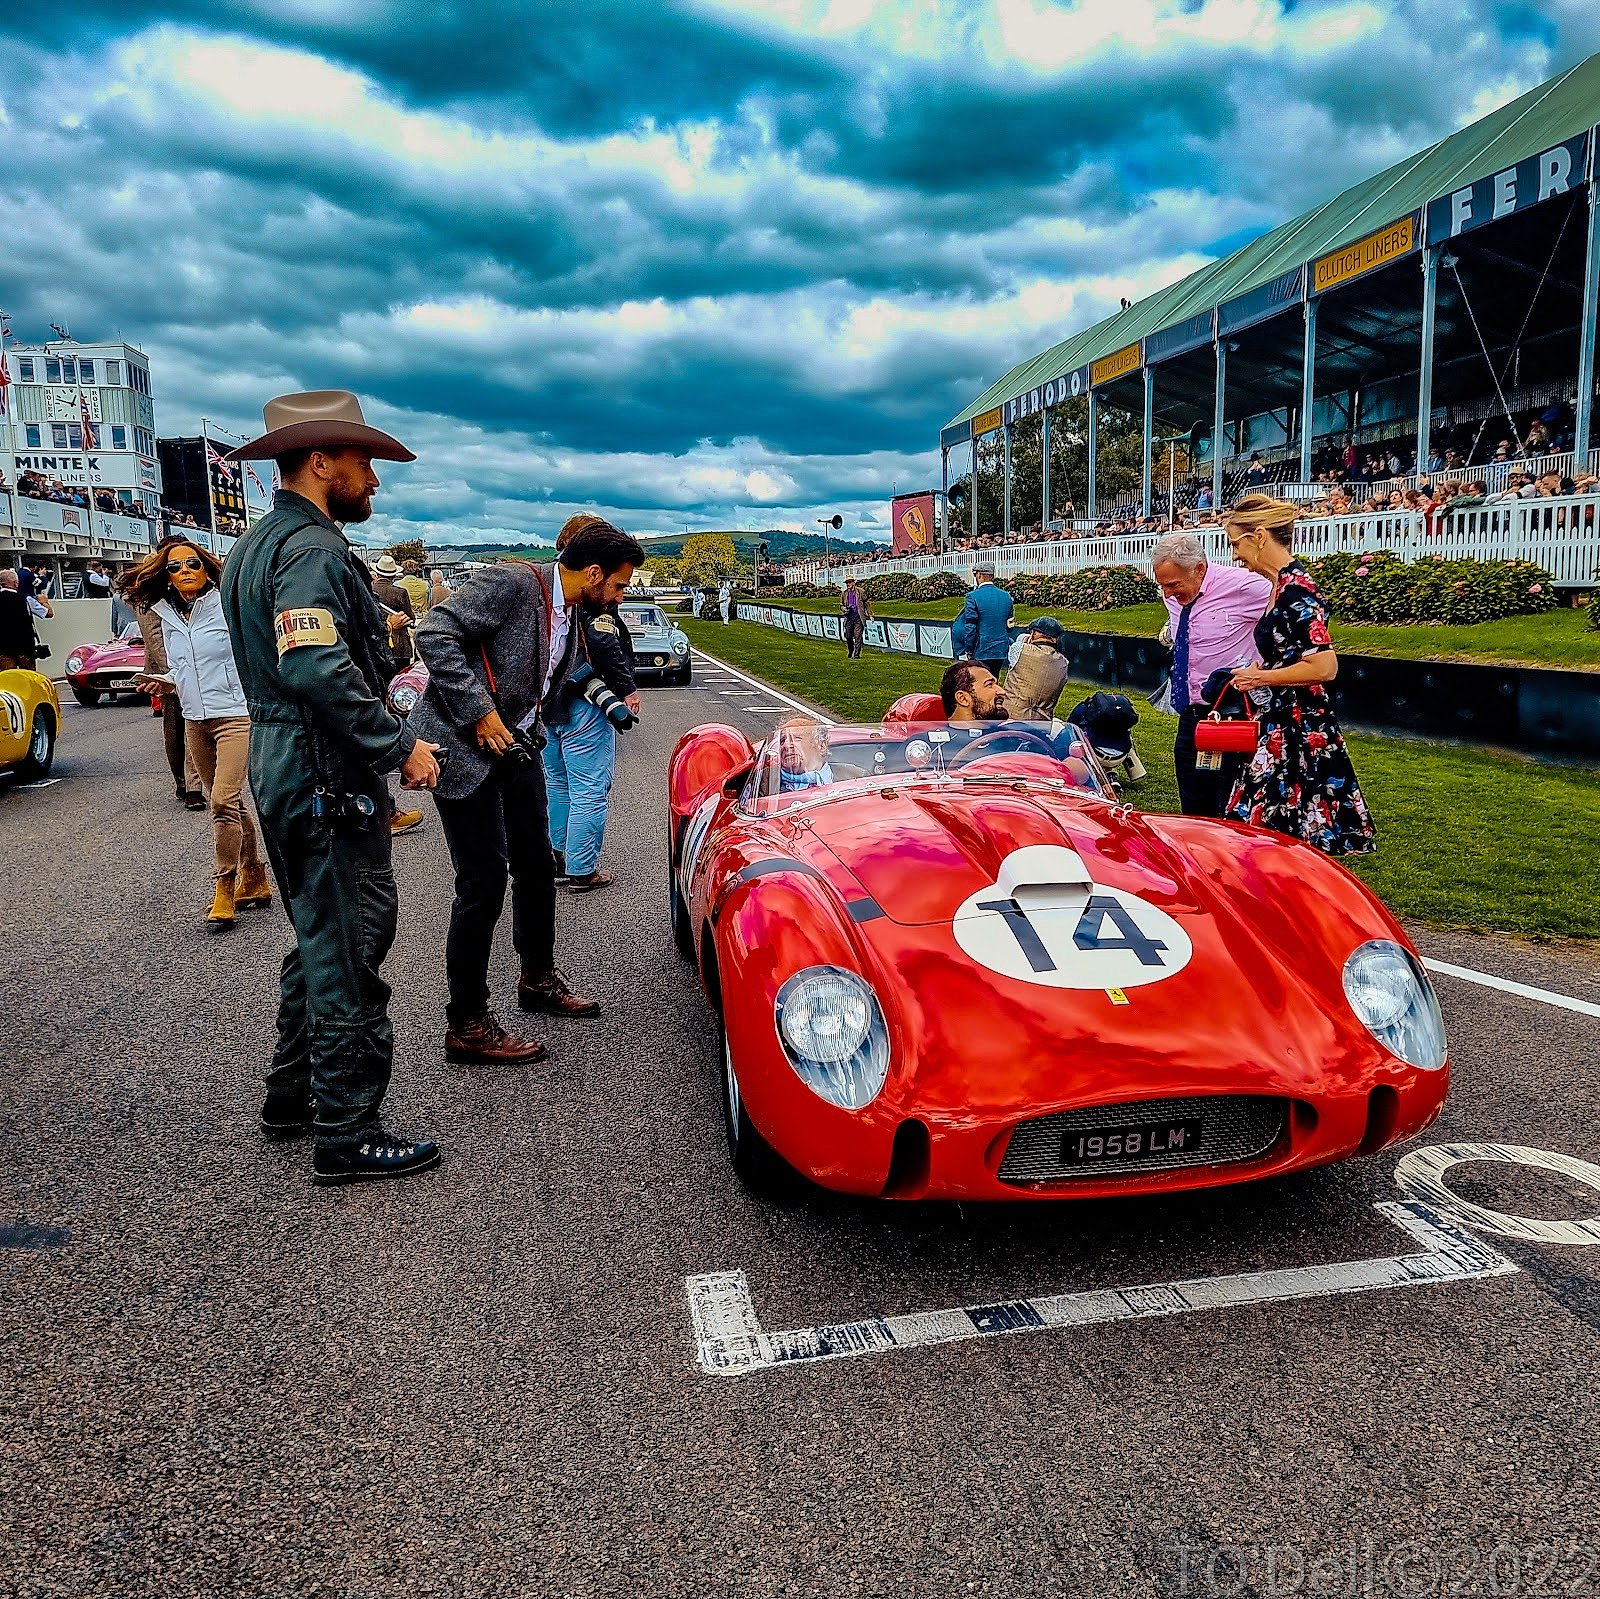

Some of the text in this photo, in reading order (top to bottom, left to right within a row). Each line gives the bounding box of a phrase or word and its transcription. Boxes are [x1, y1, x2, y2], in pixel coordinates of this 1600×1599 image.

[1450, 146, 1572, 237] FER
[1318, 226, 1409, 283] CLUTCH LINERS
[45, 389, 54, 418] ROLEX
[91, 390, 101, 419] ROLEX
[1010, 371, 1081, 423] FERODO
[13, 540, 25, 548] 15
[54, 544, 65, 553] 16
[89, 547, 100, 556] 17
[121, 551, 132, 559] 18
[976, 896, 1170, 973] 14
[1078, 1127, 1185, 1158] 1958 LM
